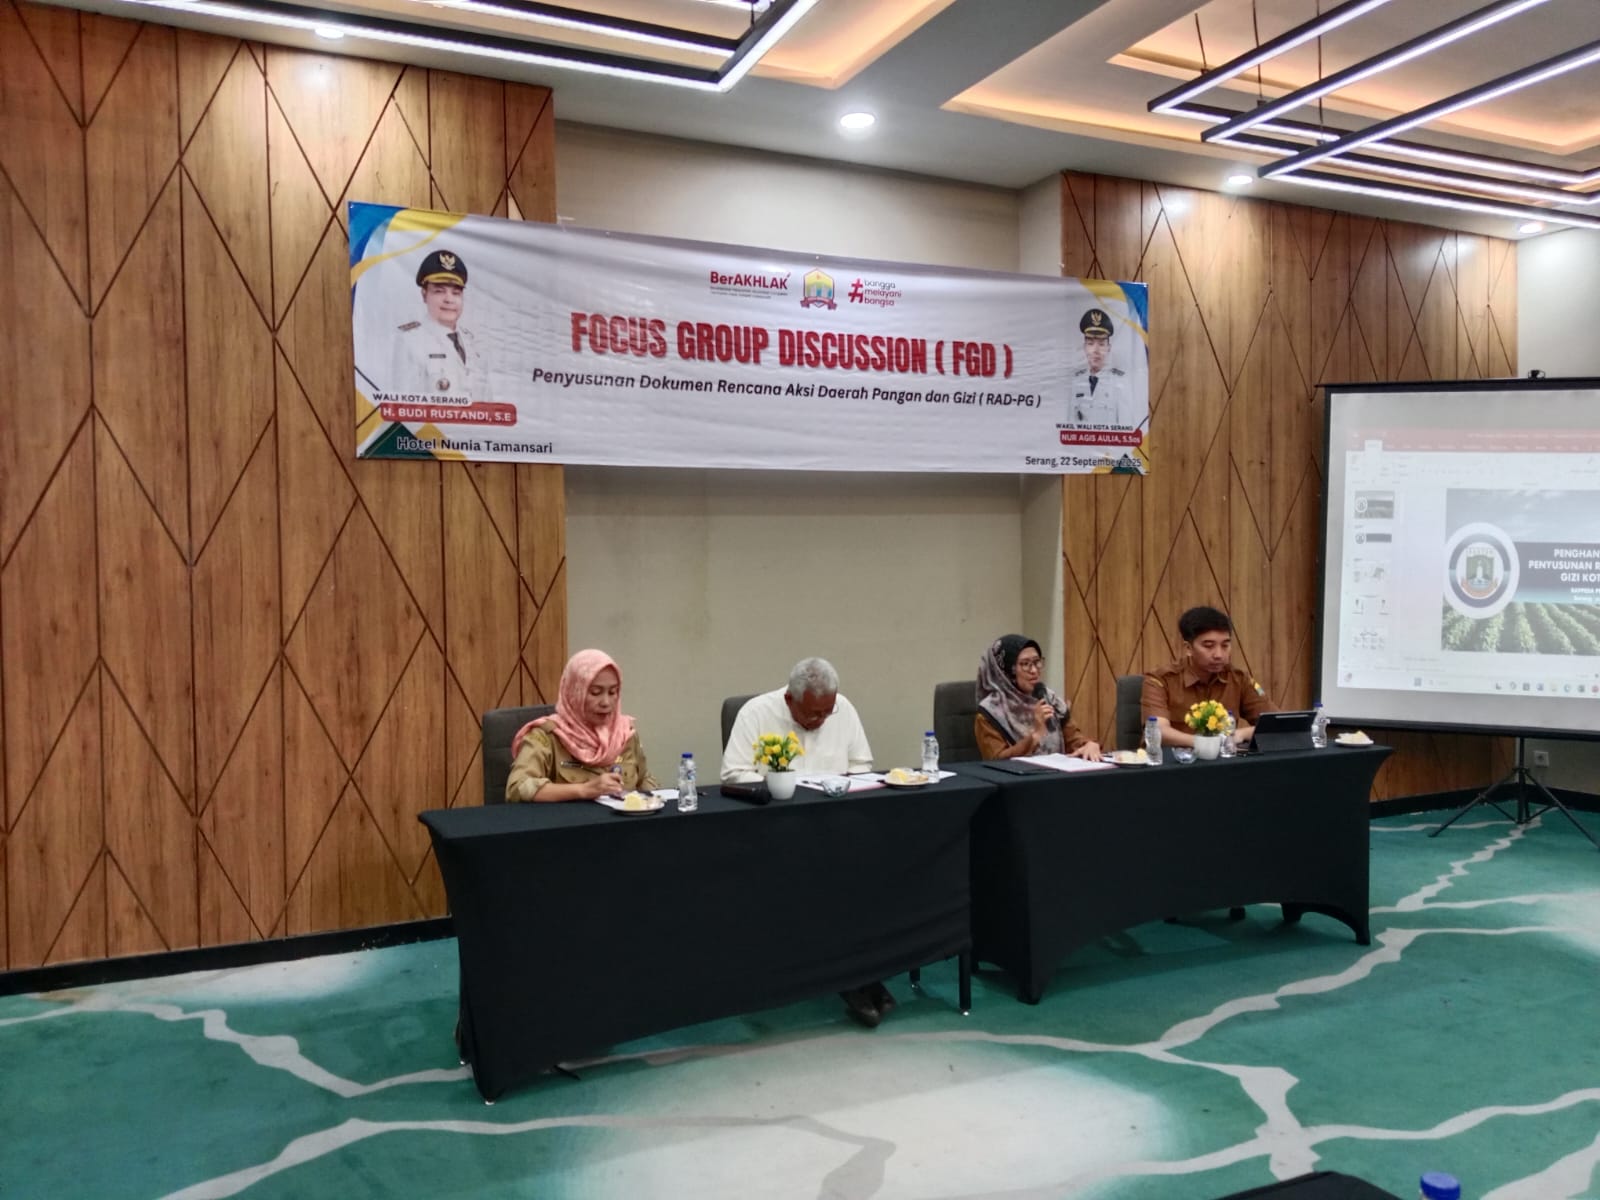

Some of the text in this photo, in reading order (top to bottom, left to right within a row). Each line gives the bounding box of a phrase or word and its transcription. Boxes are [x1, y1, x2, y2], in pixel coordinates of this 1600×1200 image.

[710, 271, 788, 290] BerAKHLAK
[864, 279, 896, 290] bangga
[864, 288, 902, 298] melayani
[864, 297, 895, 308] bangsa
[571, 312, 667, 358] FOCUS
[677, 321, 769, 365] GROUP
[778, 329, 928, 374] DISCUSSION
[953, 341, 996, 377] FGD
[532, 368, 635, 388] Penyusunan
[639, 375, 713, 392] Dokumen
[717, 380, 782, 396] Rencana
[785, 383, 815, 397] Aksi
[818, 385, 868, 400] Daerah
[872, 388, 922, 404] Pangan
[925, 390, 950, 404] dan
[953, 391, 976, 404] Gizi
[986, 393, 1034, 406] RAD-PG
[373, 393, 469, 405] WALI KOTA SERANG
[383, 408, 511, 422] H. BUDI RUSTANDI, S.E
[1061, 433, 1077, 441] NUR
[1079, 434, 1096, 442] AGIS
[1097, 435, 1121, 443] AULIA,
[397, 437, 553, 453] Hotel Nunia Tamansari
[1025, 456, 1059, 467] Serang,
[1060, 457, 1071, 465] 22
[1072, 457, 1120, 467] September
[1528, 560, 1593, 570] PENYUSUNAN
[1560, 573, 1580, 582] GIZI
